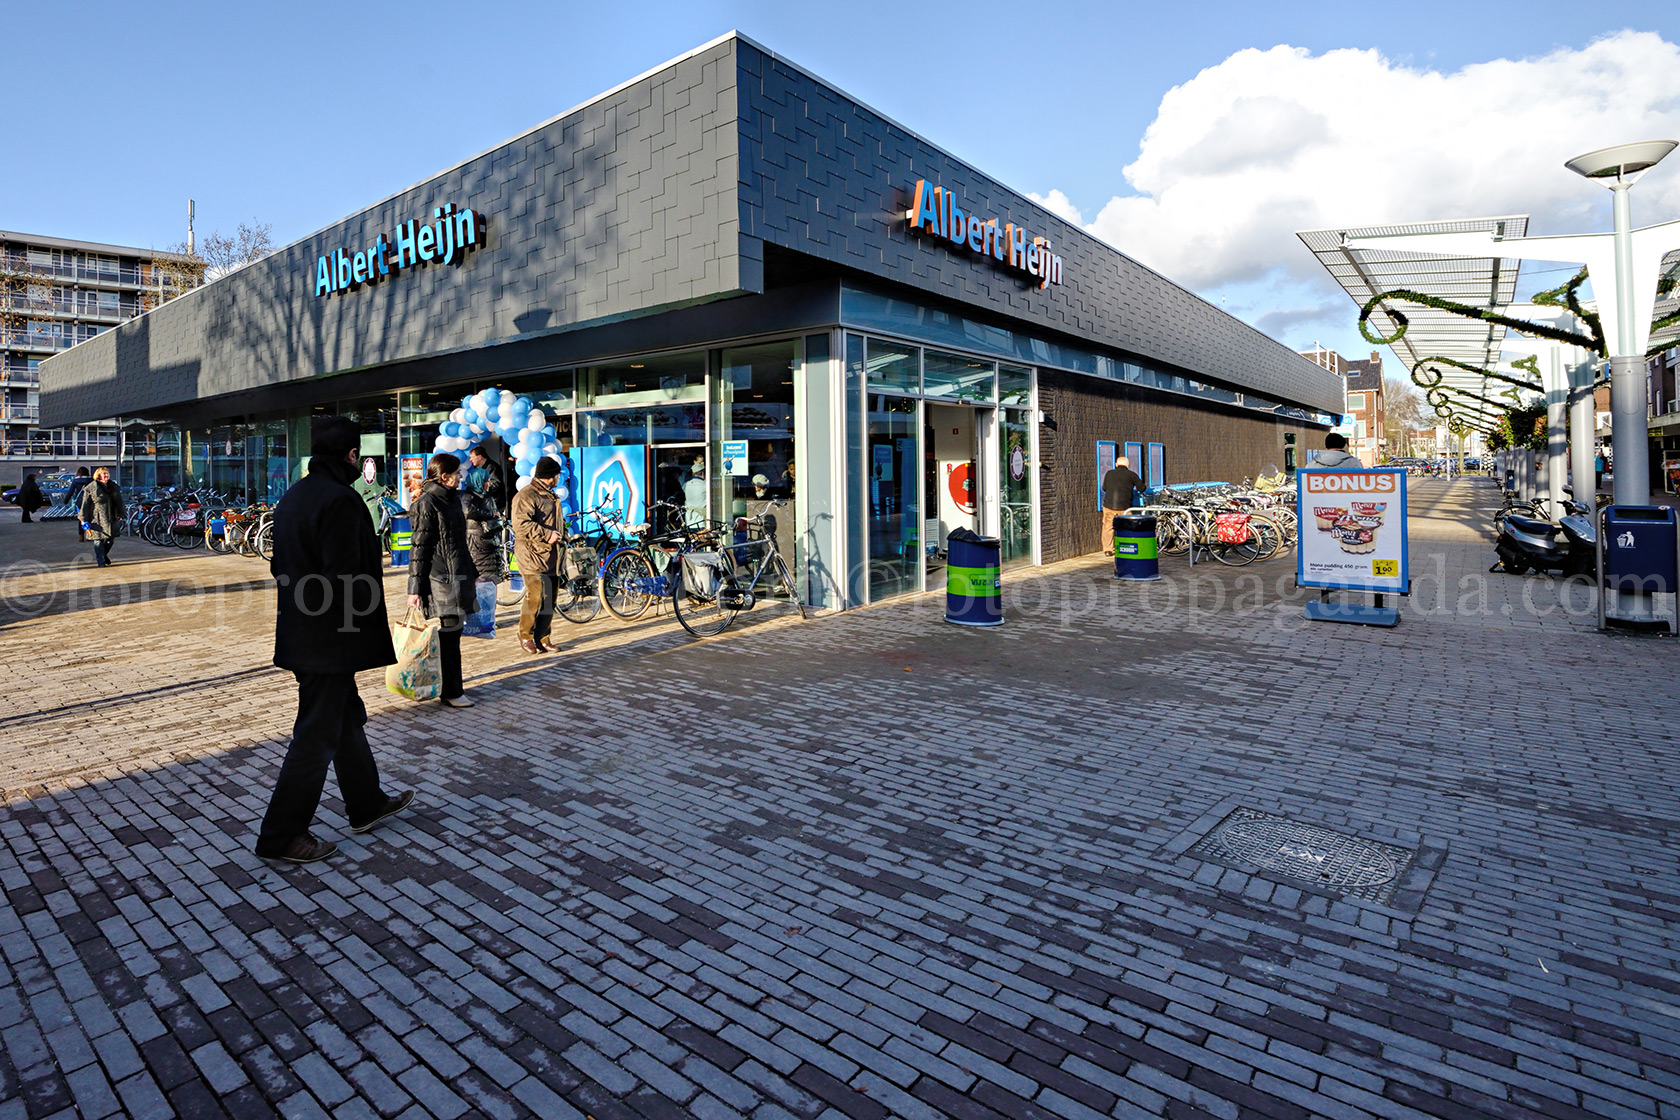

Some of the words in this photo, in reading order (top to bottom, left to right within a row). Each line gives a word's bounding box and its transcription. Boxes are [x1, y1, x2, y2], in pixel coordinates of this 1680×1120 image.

[315, 233, 391, 297] Albert
[396, 202, 478, 269] Heijn
[910, 179, 1003, 261] Albert
[1005, 223, 1063, 290] Heijn
[403, 460, 423, 469] BONUS
[1309, 475, 1393, 491] BONUS
